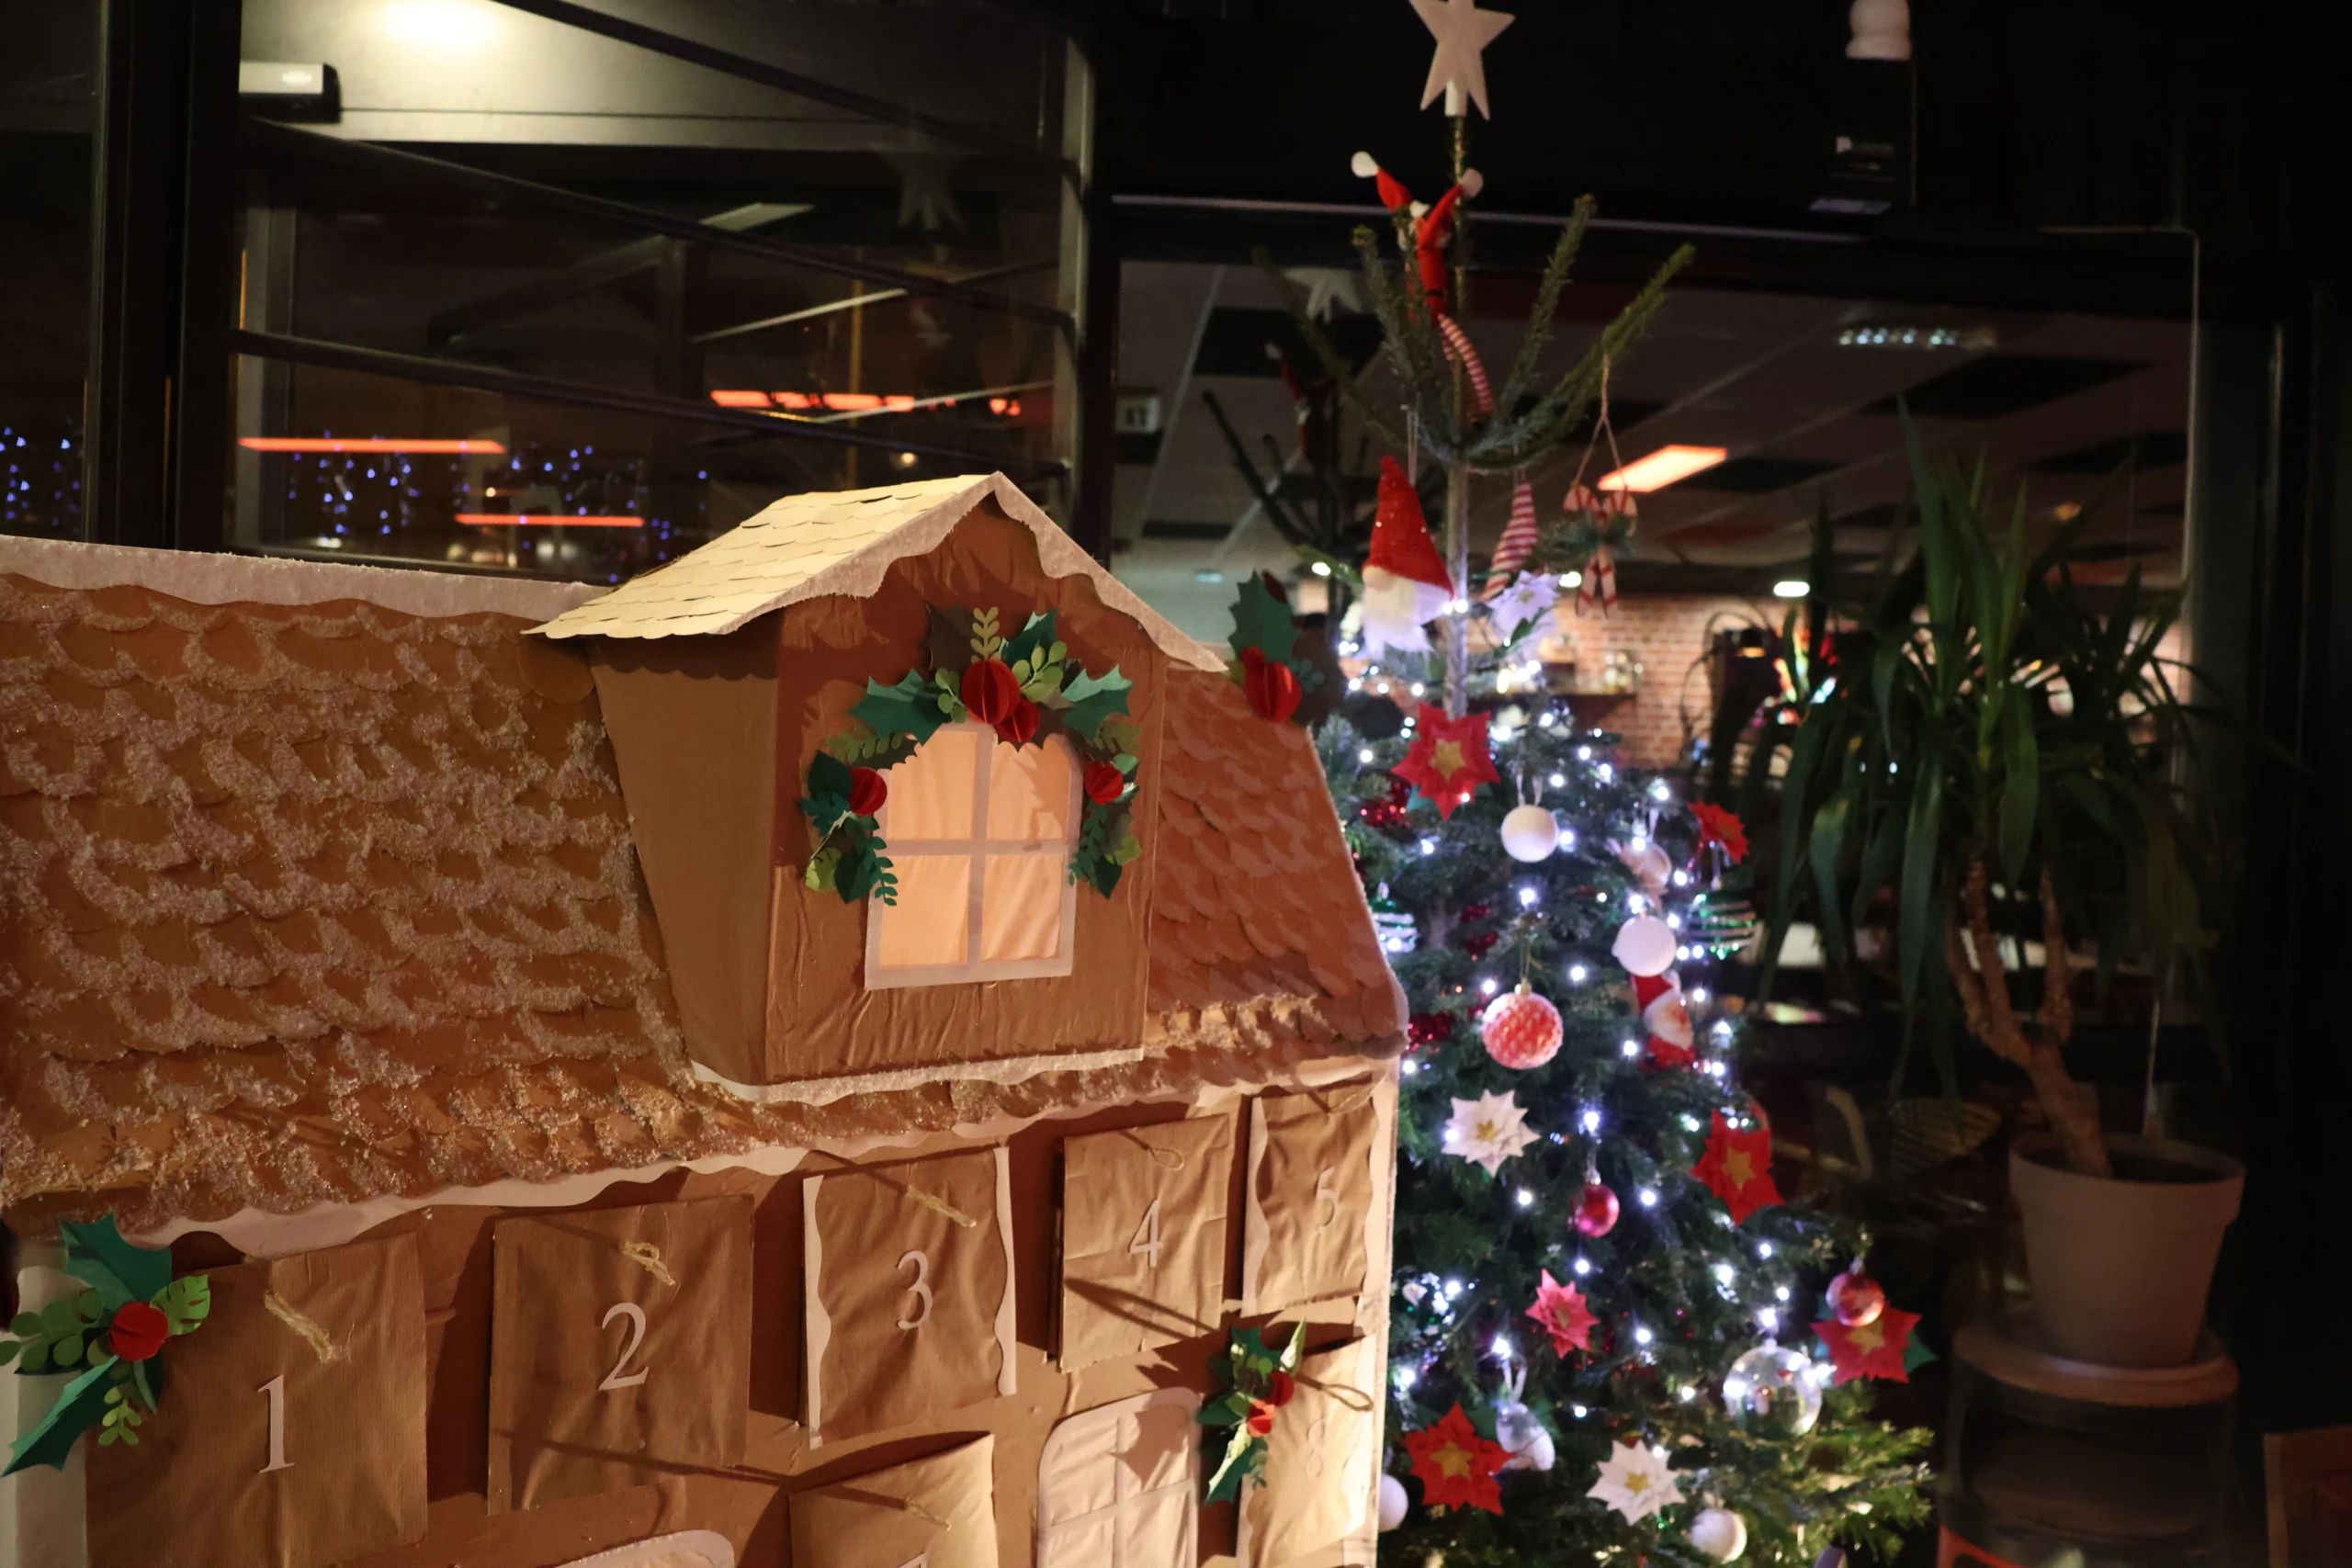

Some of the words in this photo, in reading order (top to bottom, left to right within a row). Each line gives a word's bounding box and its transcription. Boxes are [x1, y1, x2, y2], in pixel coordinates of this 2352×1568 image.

[1129, 1200, 1164, 1268] 4
[1316, 1166, 1339, 1235] 5
[898, 1250, 933, 1330] 3
[598, 1303, 649, 1390] 2
[257, 1374, 295, 1473] 1
[1306, 1418, 1328, 1479] 8
